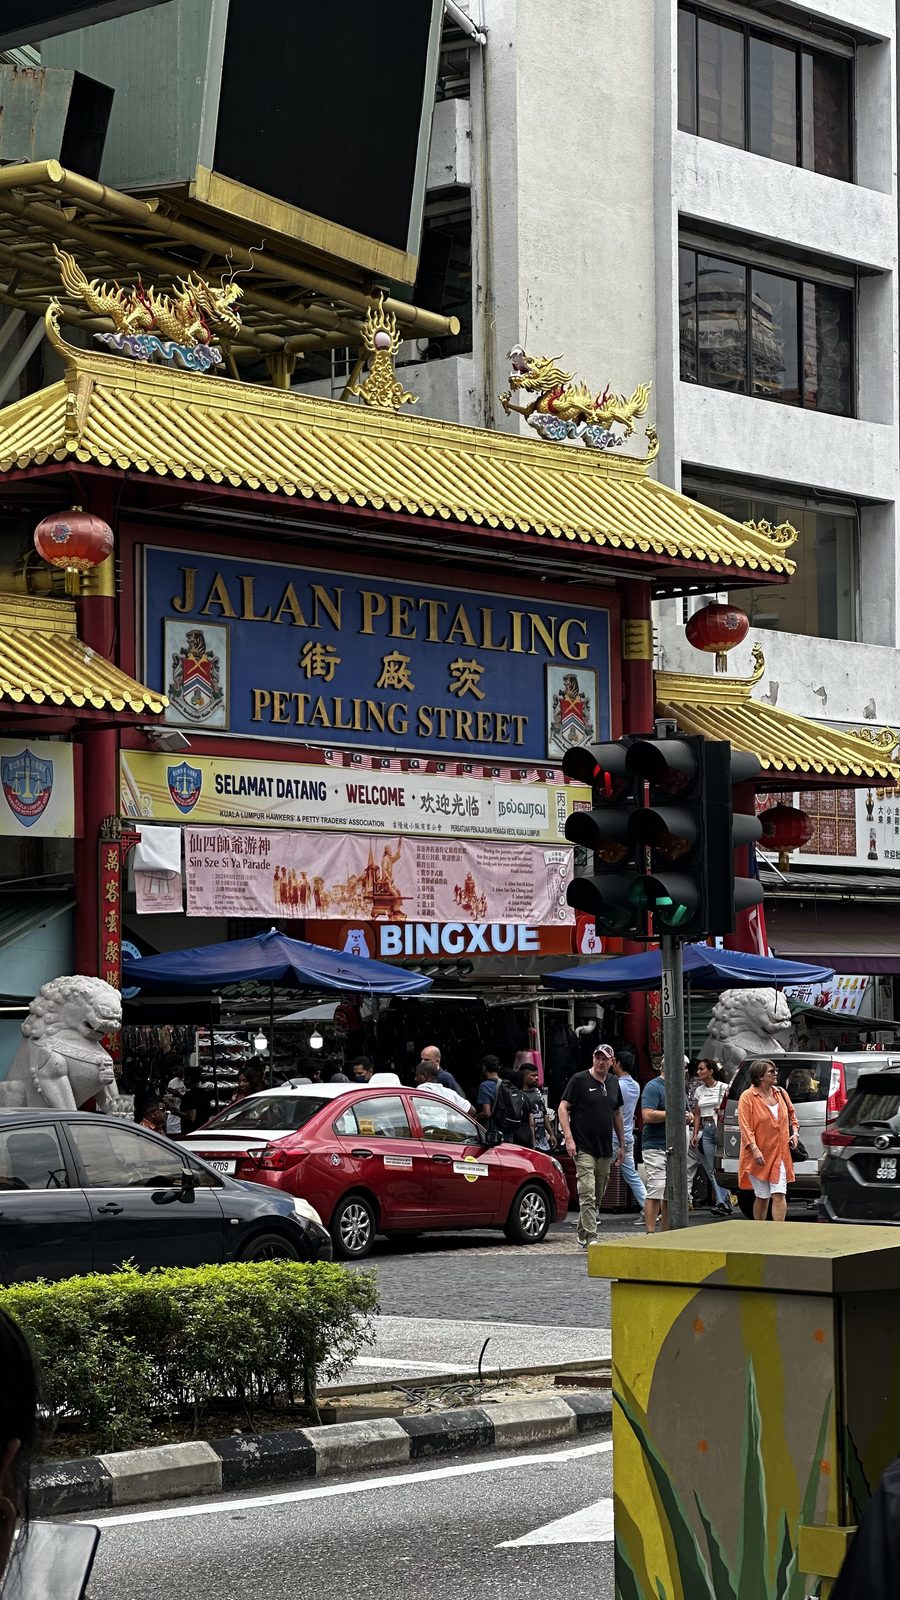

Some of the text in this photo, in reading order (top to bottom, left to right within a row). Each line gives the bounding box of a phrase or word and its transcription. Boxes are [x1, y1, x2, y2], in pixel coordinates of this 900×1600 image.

[172, 566, 591, 661] JALAN PETALING
[251, 688, 529, 746] PETALING STREET
[214, 773, 274, 798] SELAMAT
[276, 778, 328, 802] DATANG
[345, 783, 406, 807] WELCOME
[419, 792, 481, 818] 欢迎光临
[219, 810, 240, 819] KUALA
[240, 811, 265, 820] LUMPUR
[301, 815, 320, 824] PETTY
[348, 818, 385, 828] ASSOCIATION
[498, 798, 546, 819] நல்வரவு
[189, 857, 271, 870] Sin Sze Si Ya Parade
[380, 922, 541, 956] BINGXUE
[663, 973, 671, 1016] 130
